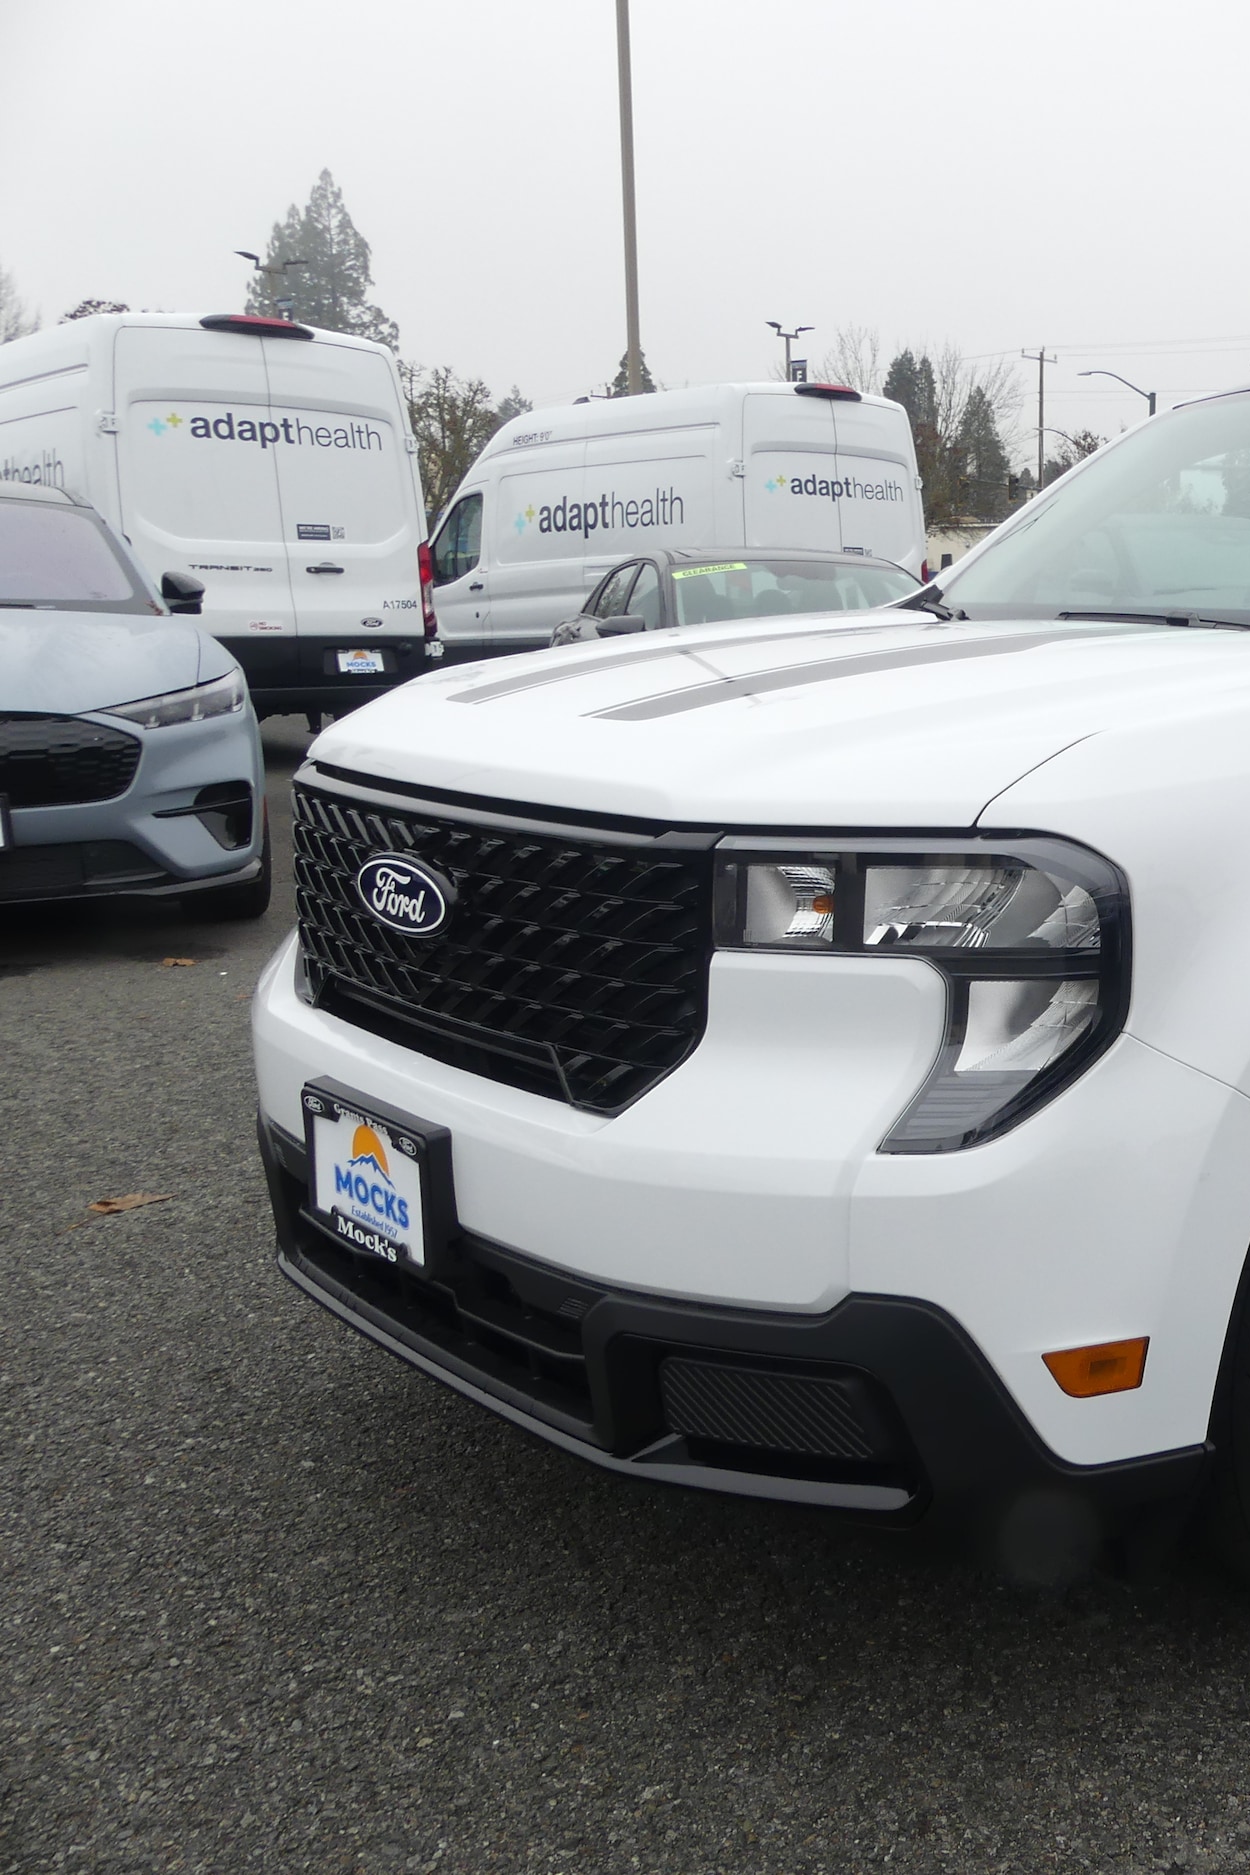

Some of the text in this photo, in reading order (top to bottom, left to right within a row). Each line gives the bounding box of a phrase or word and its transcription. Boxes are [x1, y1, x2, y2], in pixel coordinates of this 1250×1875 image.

[190, 412, 382, 451] adapthealth
[790, 474, 904, 502] adapthealth
[539, 486, 684, 539] adapthealth
[383, 600, 418, 610] A17504
[372, 867, 426, 923] Ford
[334, 1162, 410, 1230] MOCKS
[337, 1215, 398, 1262] Mock's
[350, 1205, 384, 1231] Established
